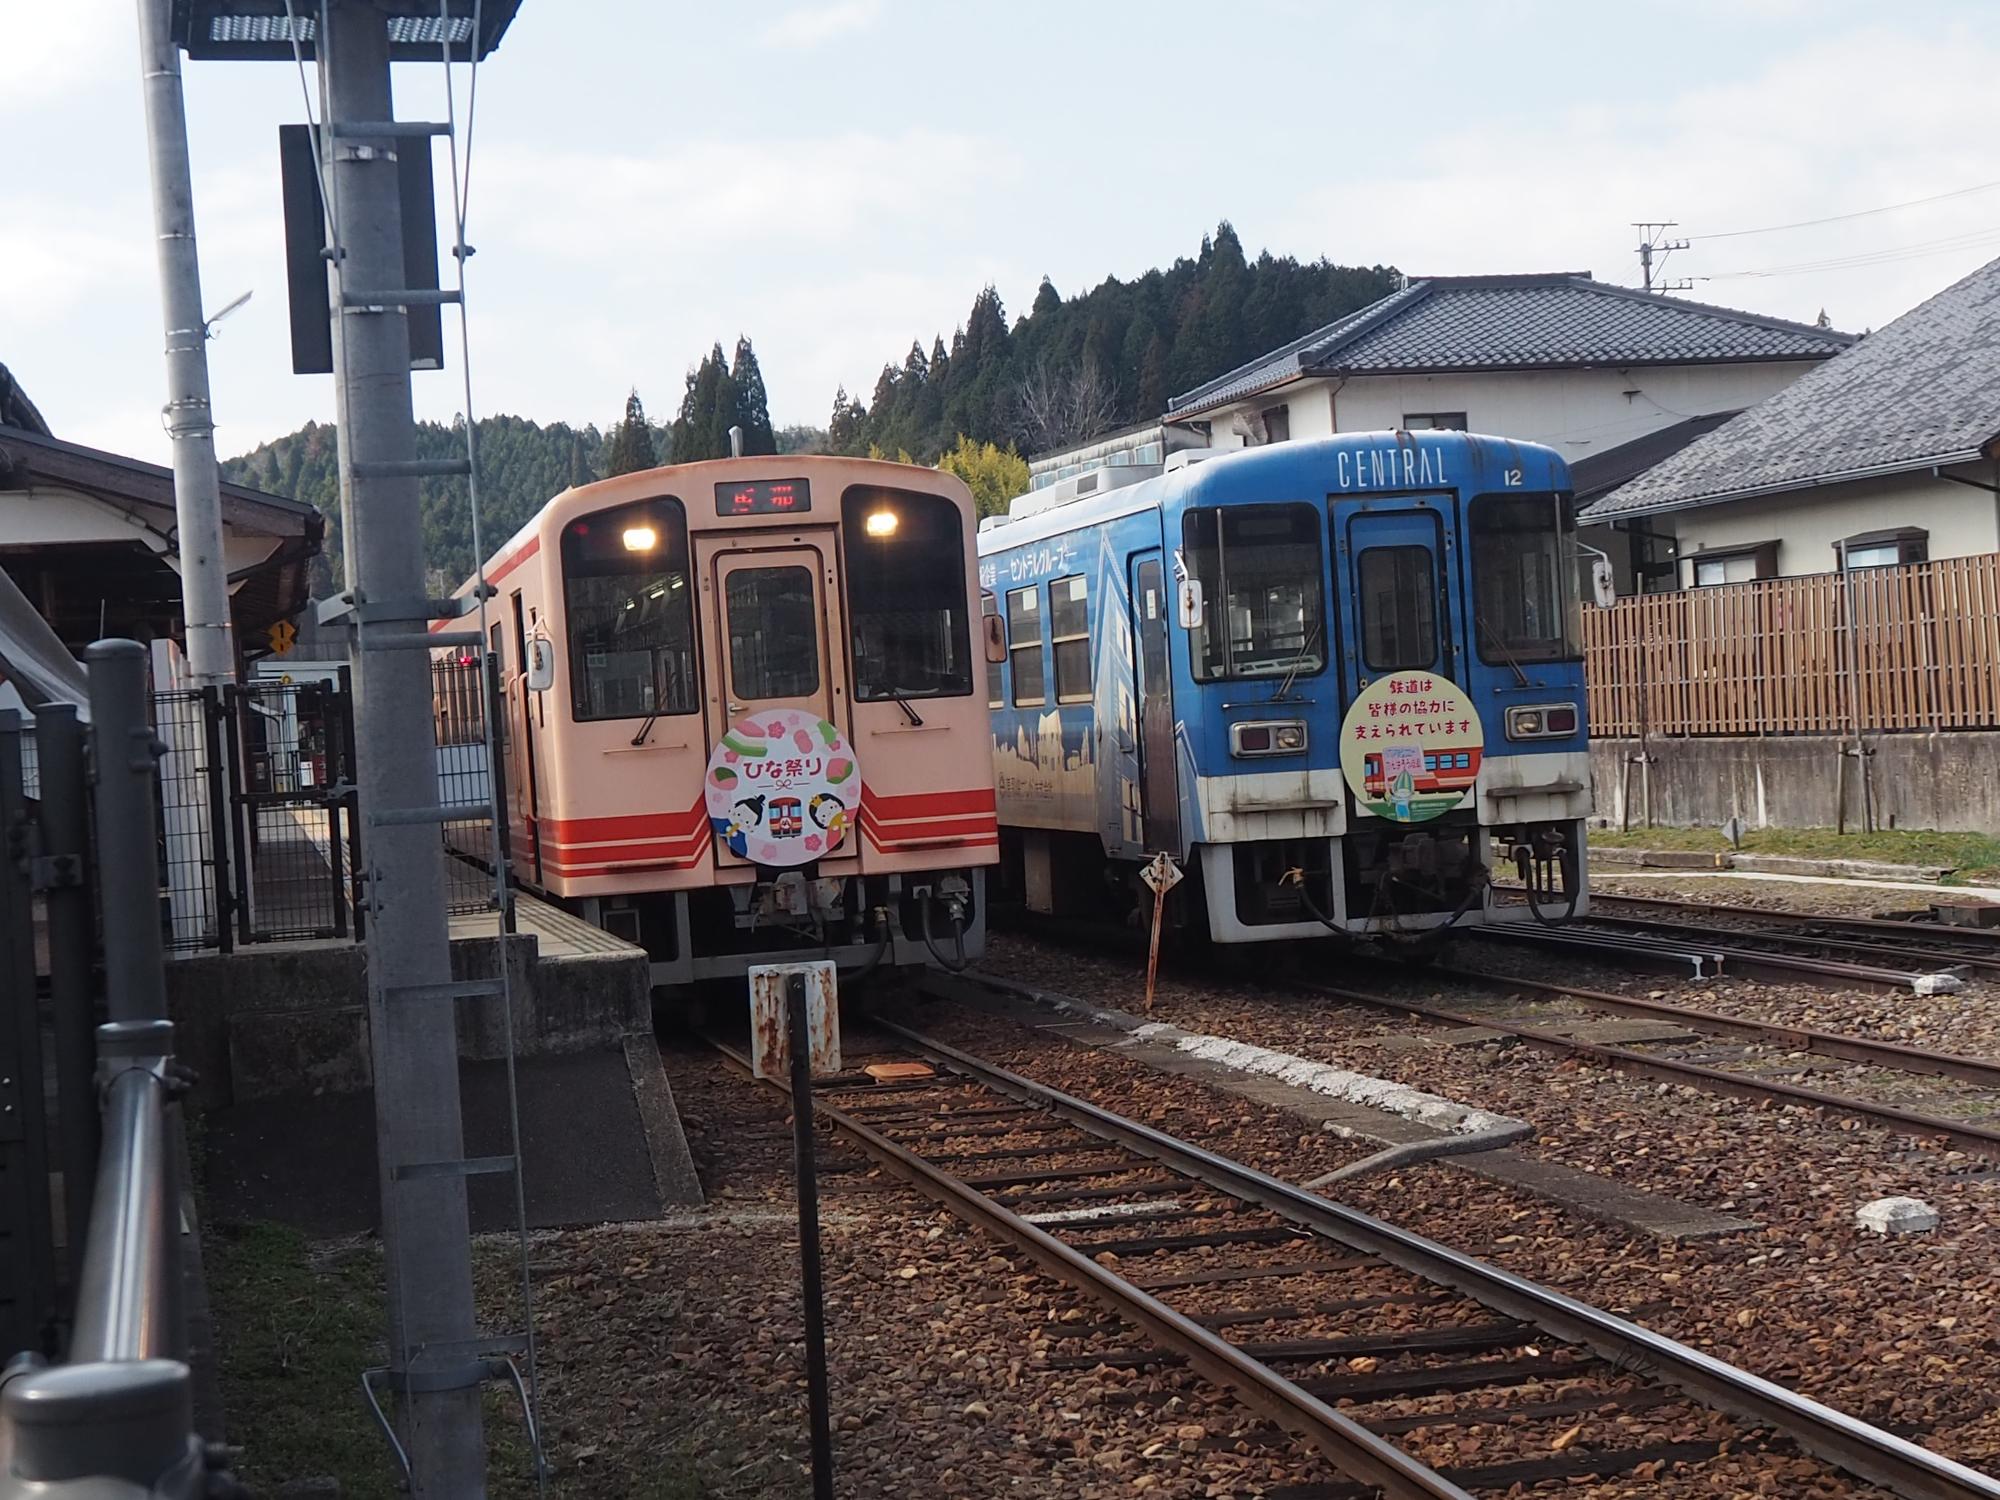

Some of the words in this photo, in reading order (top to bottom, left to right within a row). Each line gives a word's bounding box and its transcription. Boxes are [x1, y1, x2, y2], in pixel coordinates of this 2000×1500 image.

[1337, 448, 1448, 488] CENTRAL
[1504, 470, 1522, 487] 12
[1389, 679, 1433, 694] 鉄道は
[1368, 700, 1456, 718] 皆様の協力に
[1355, 720, 1470, 740] 支えられています
[743, 757, 822, 779] ひな祭り
